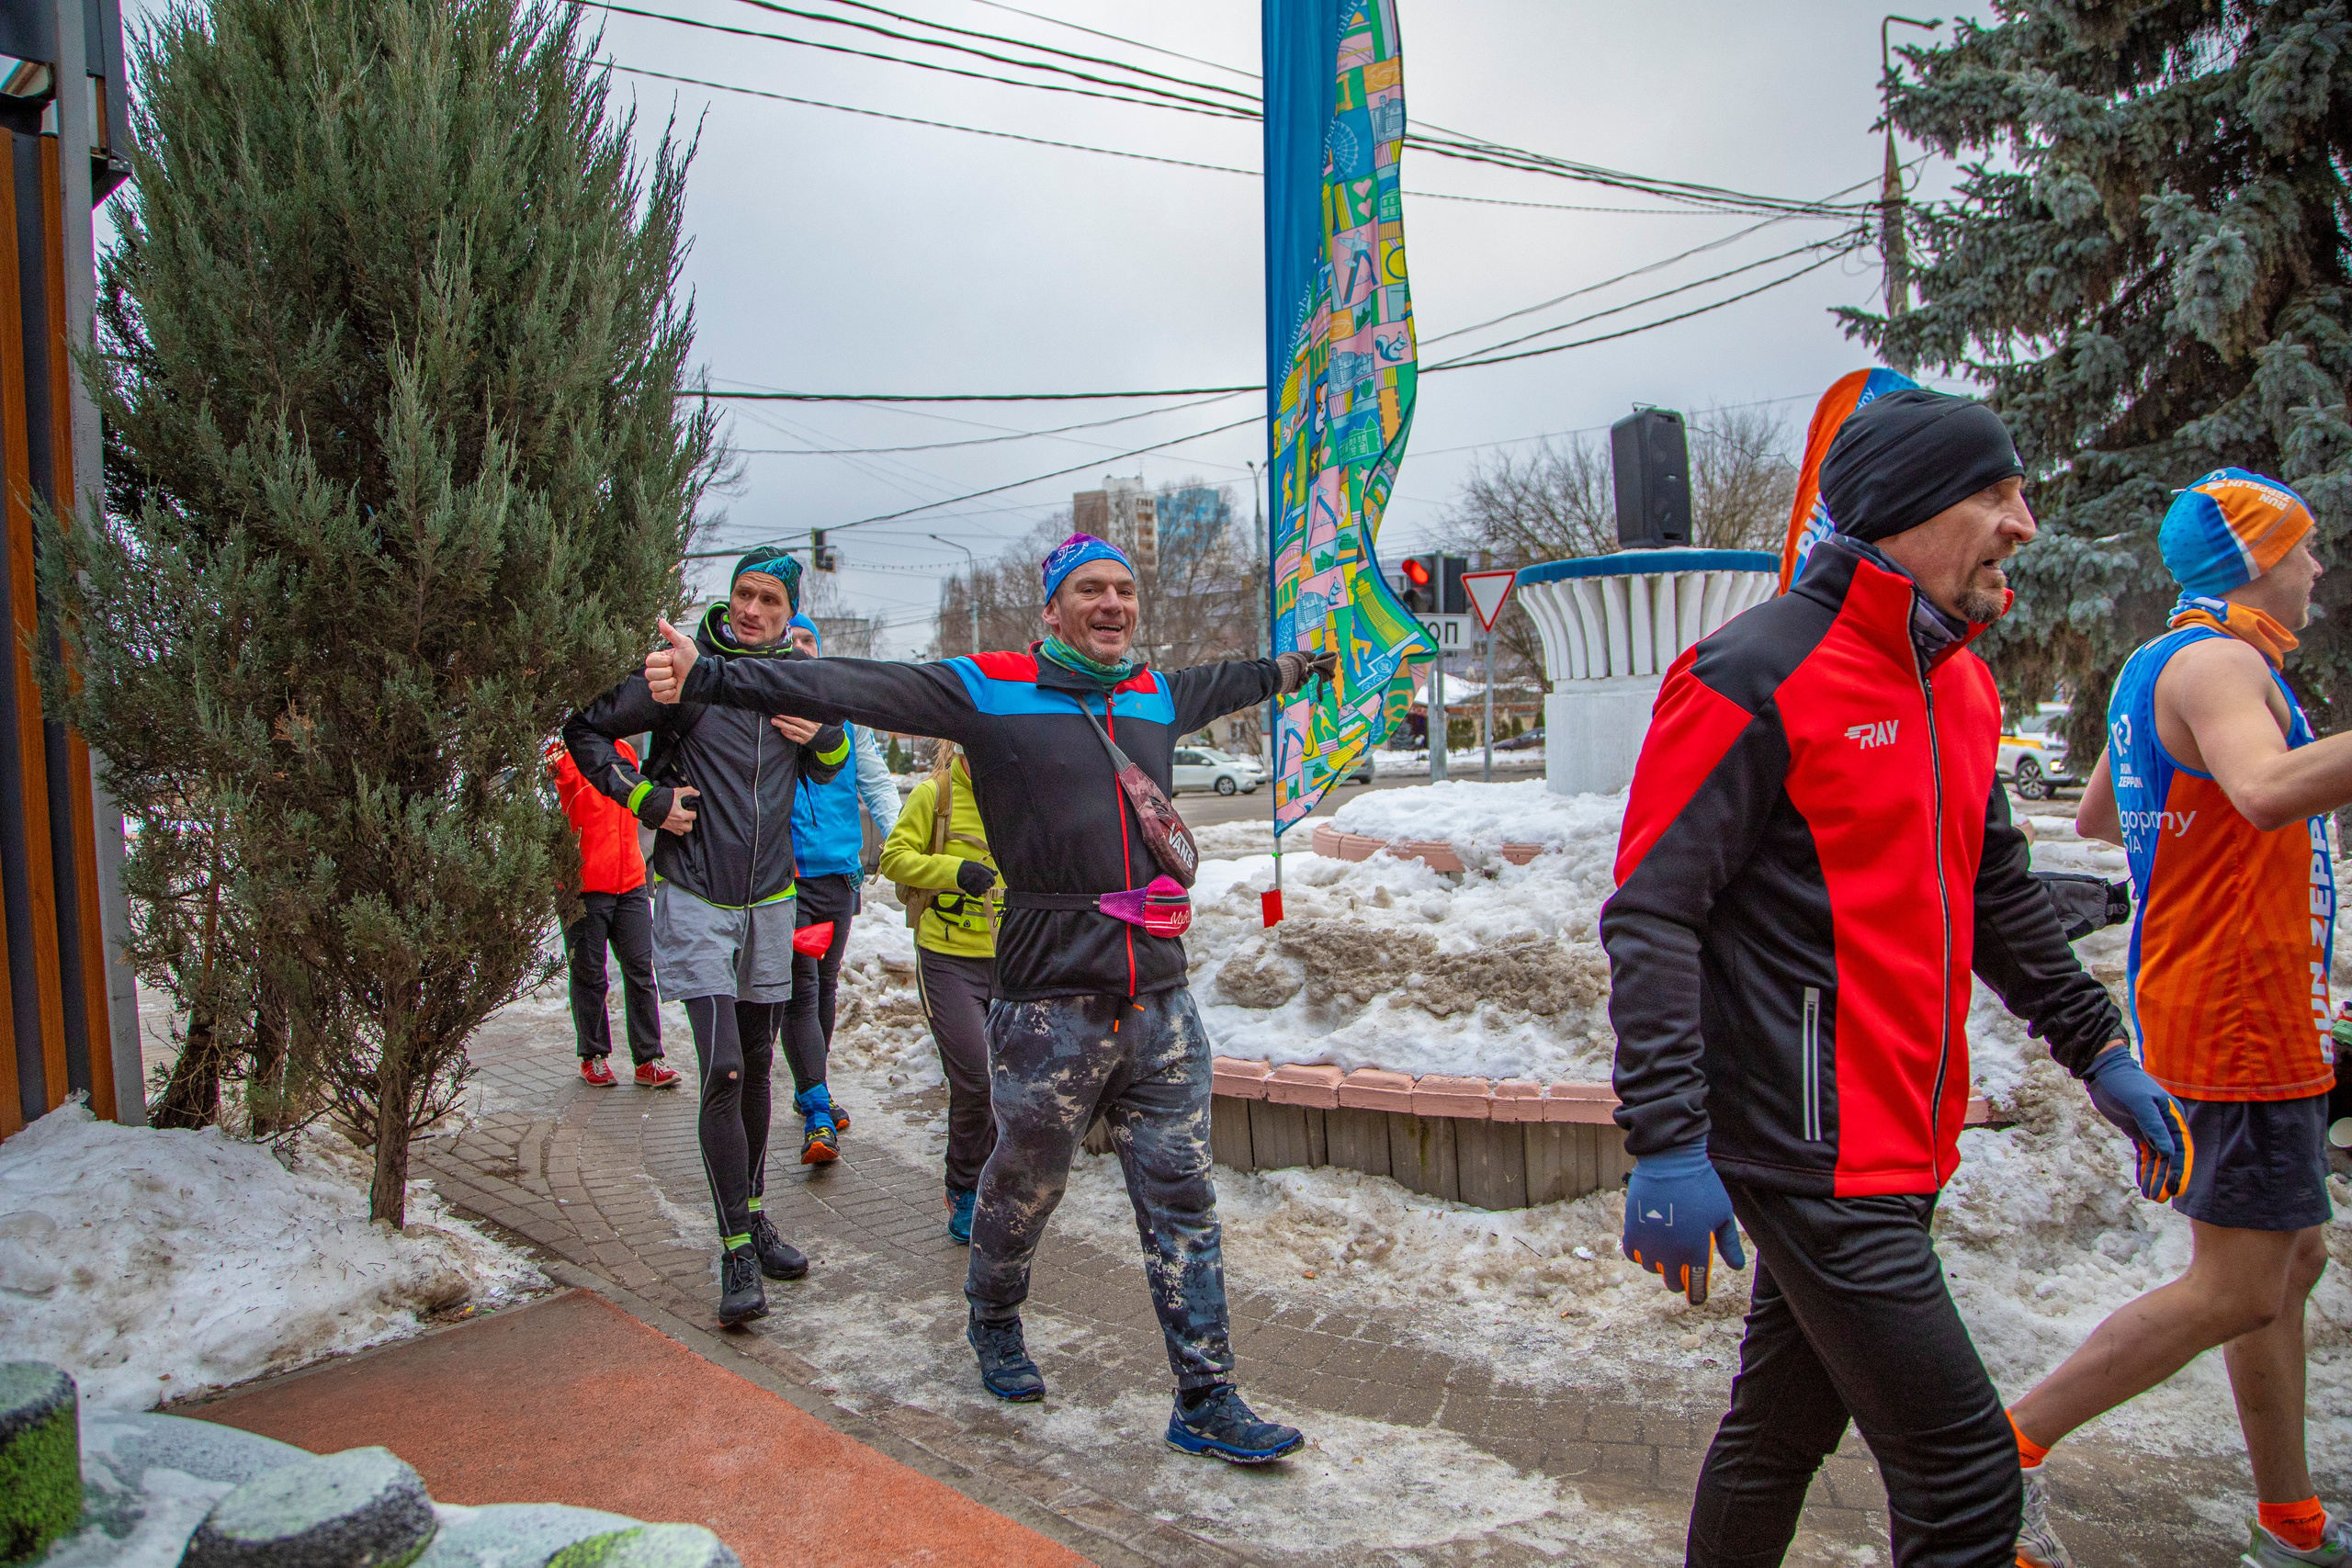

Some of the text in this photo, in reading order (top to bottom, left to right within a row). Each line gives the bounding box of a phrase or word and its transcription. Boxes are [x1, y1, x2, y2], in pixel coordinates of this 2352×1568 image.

[2226, 479, 2293, 503] ZEPPELIN
[2256, 492, 2288, 512] RUN
[1424, 621, 1458, 644] ОП
[1843, 718, 1899, 750] RAY
[1169, 822, 1195, 870] VANS
[2309, 815, 2335, 1065] RUN ZEPP
